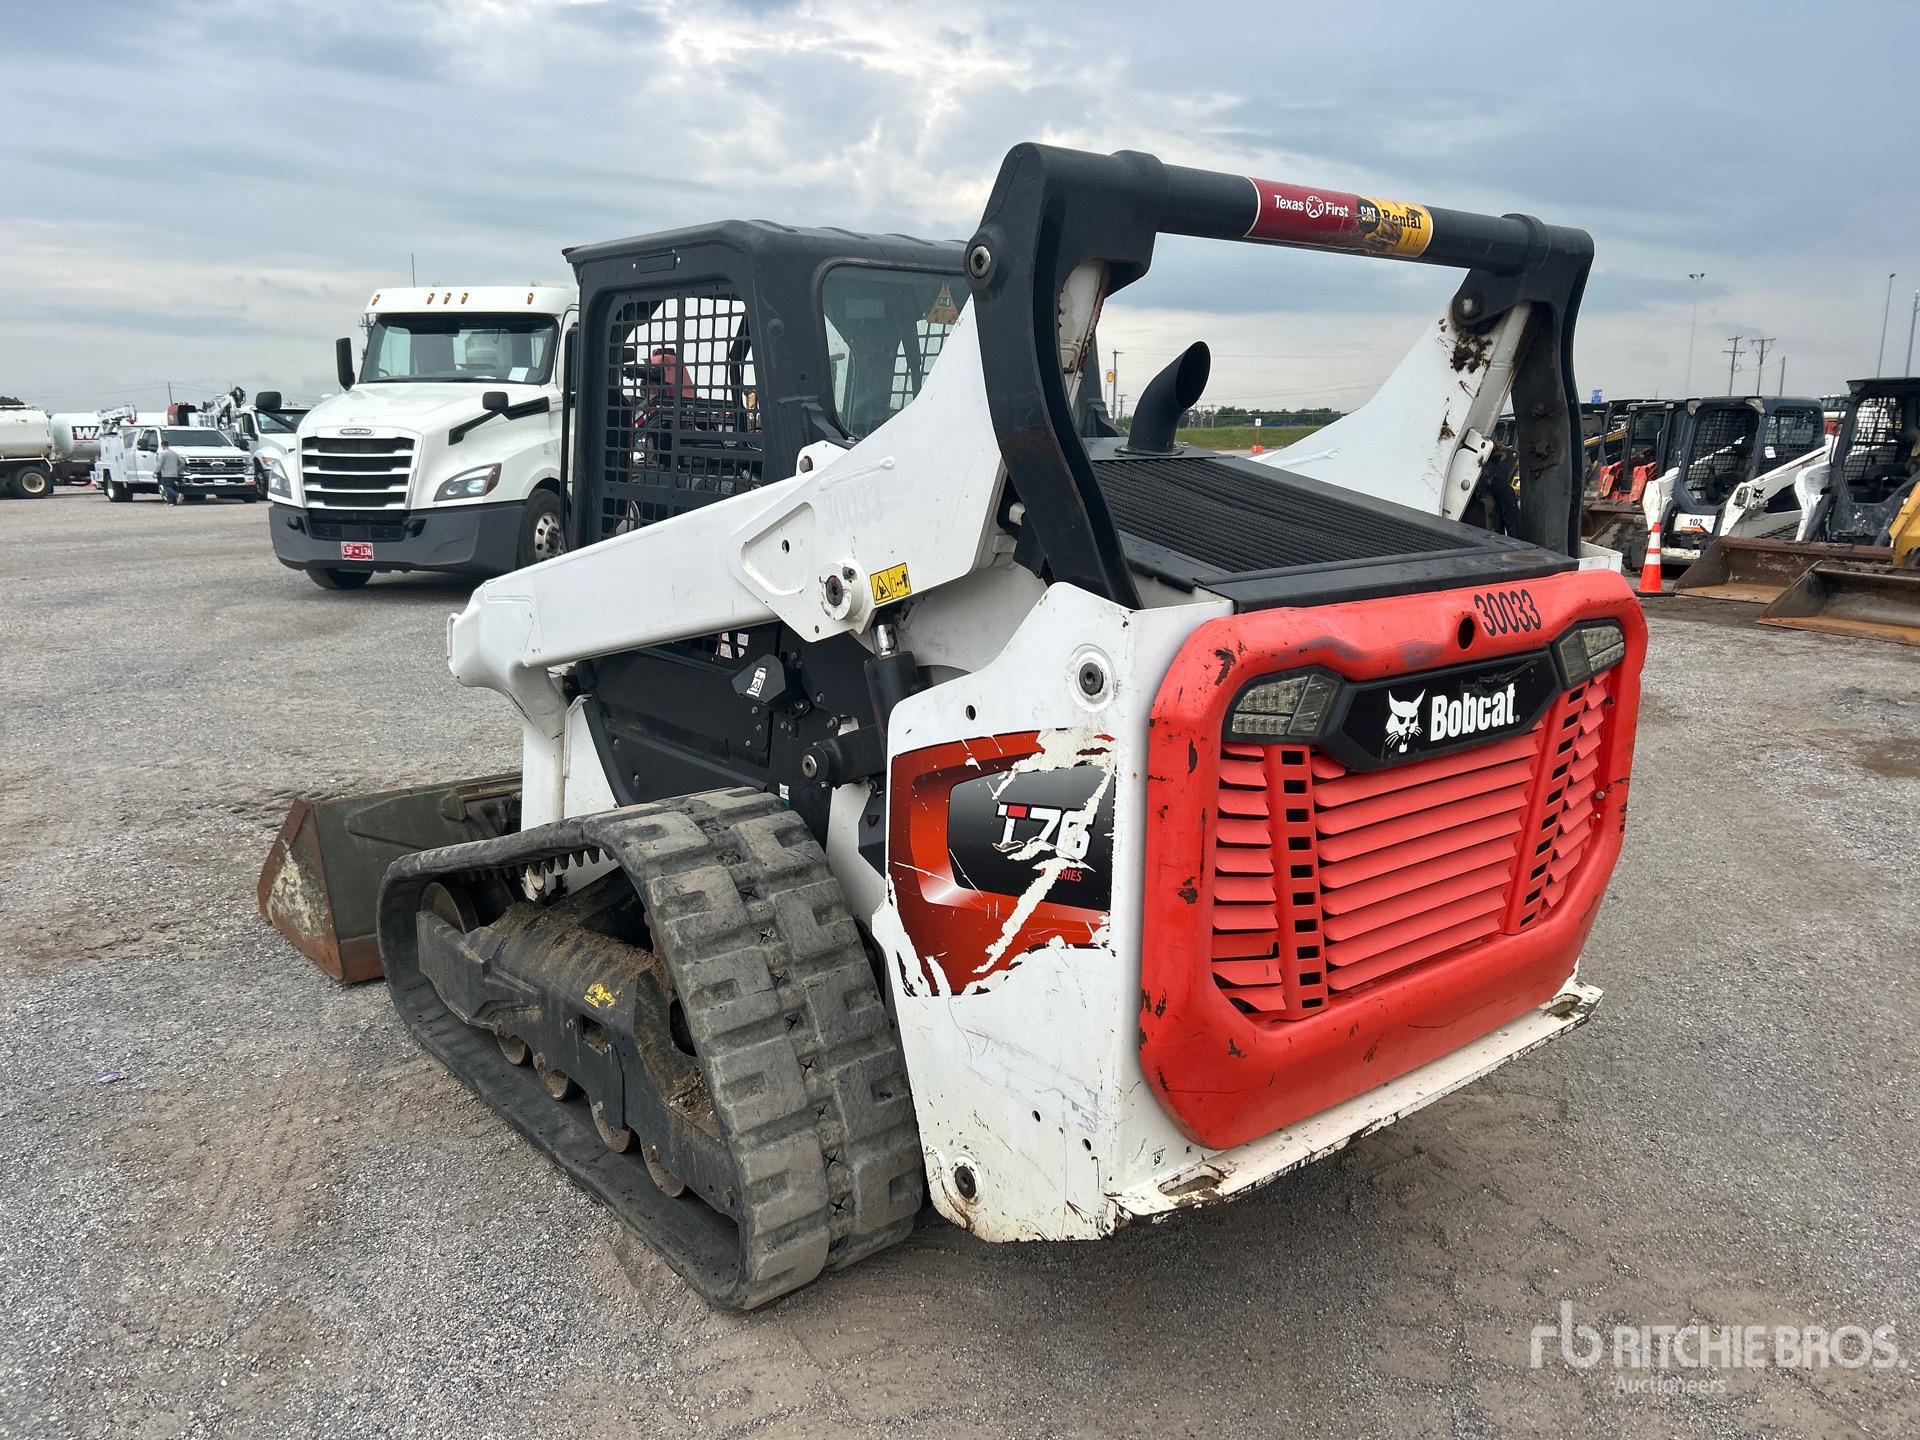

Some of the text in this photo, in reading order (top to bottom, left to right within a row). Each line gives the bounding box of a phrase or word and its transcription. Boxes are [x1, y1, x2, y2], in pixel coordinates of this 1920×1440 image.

[1274, 195, 1348, 218] Texas First
[1360, 206, 1422, 229] CAT Rental
[360, 547, 372, 556] 136
[1474, 588, 1542, 637] 30033
[1430, 683, 1516, 742] Bobcat
